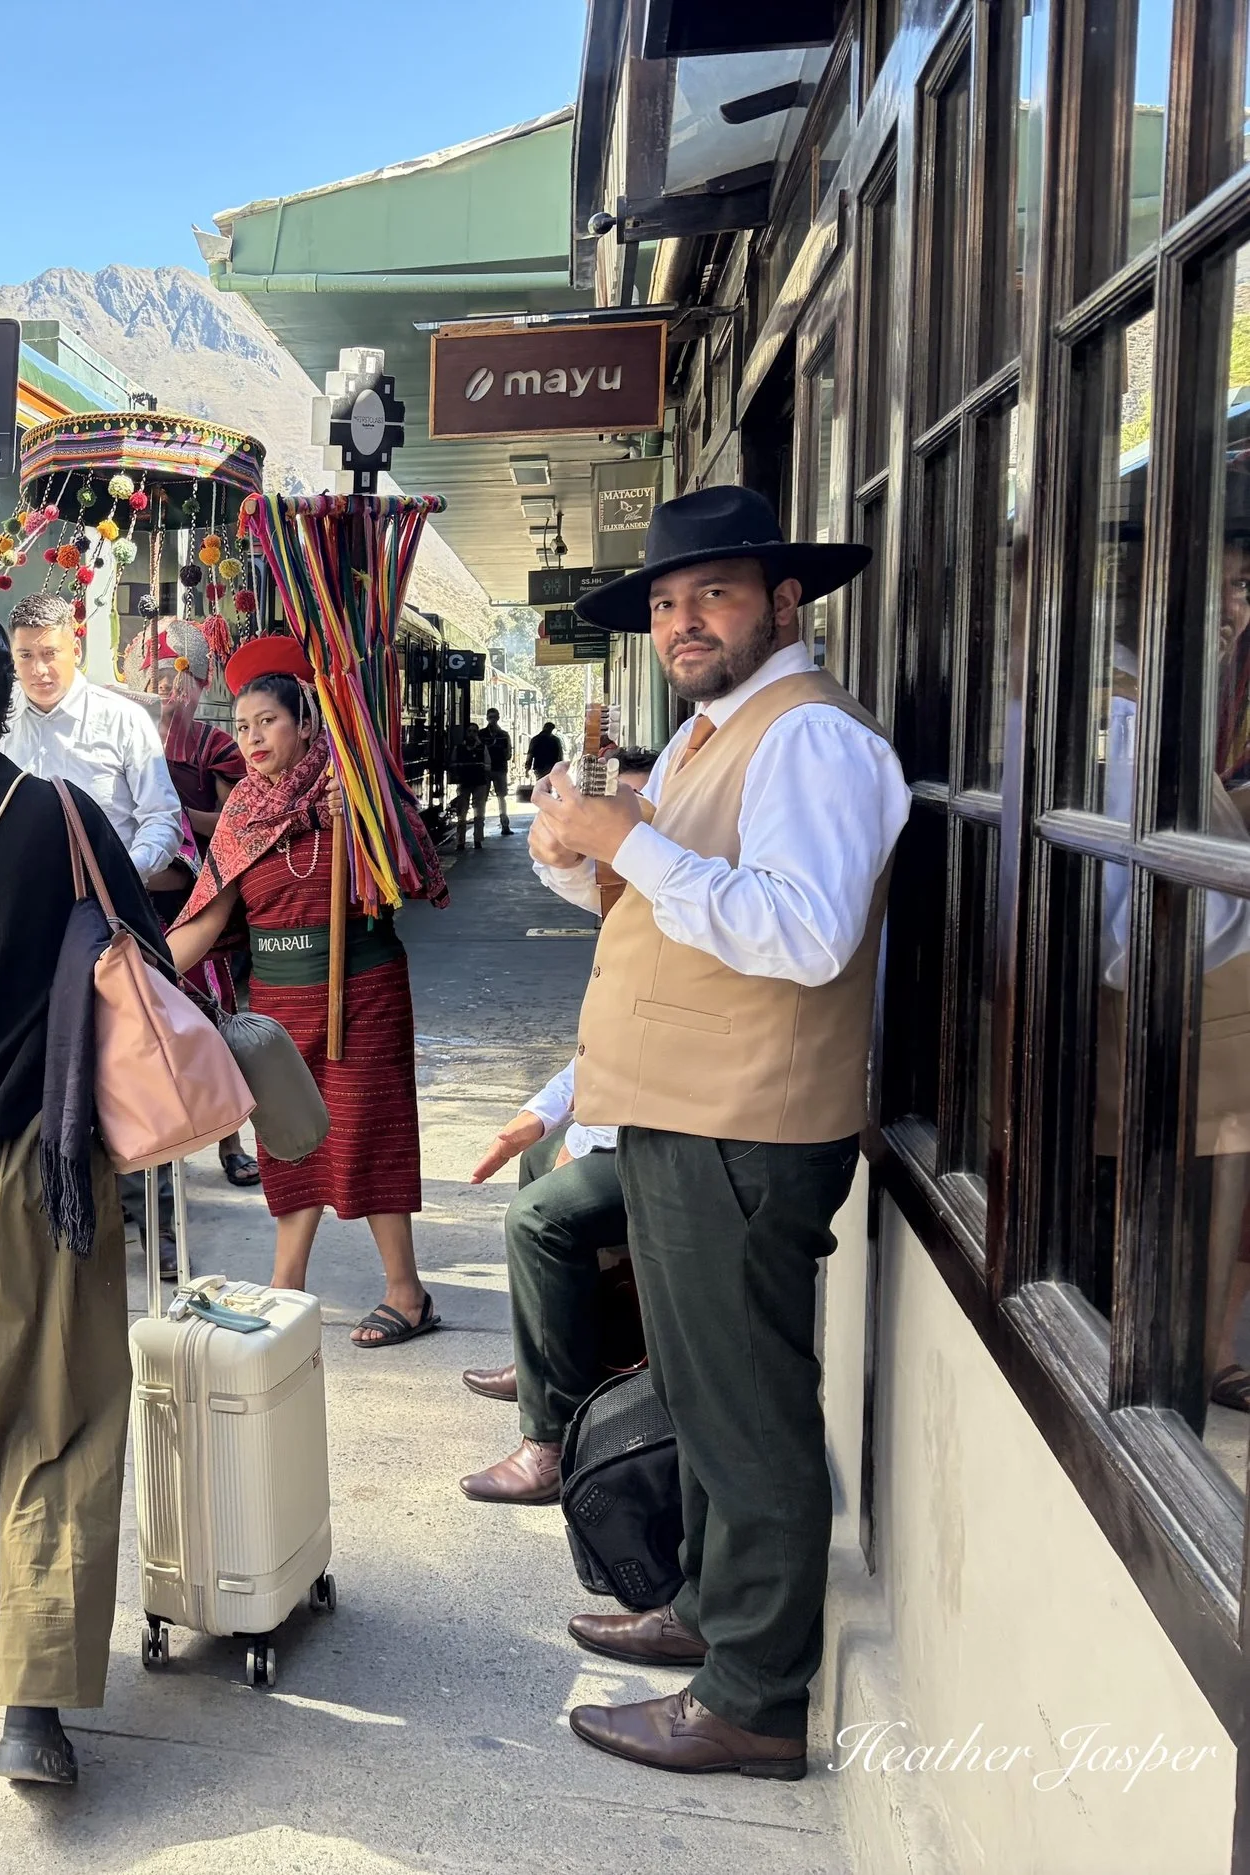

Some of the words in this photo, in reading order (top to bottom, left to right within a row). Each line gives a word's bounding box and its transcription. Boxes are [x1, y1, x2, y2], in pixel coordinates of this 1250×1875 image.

[503, 364, 623, 398] mayu
[604, 487, 651, 501] MATACUY
[448, 653, 466, 670] G
